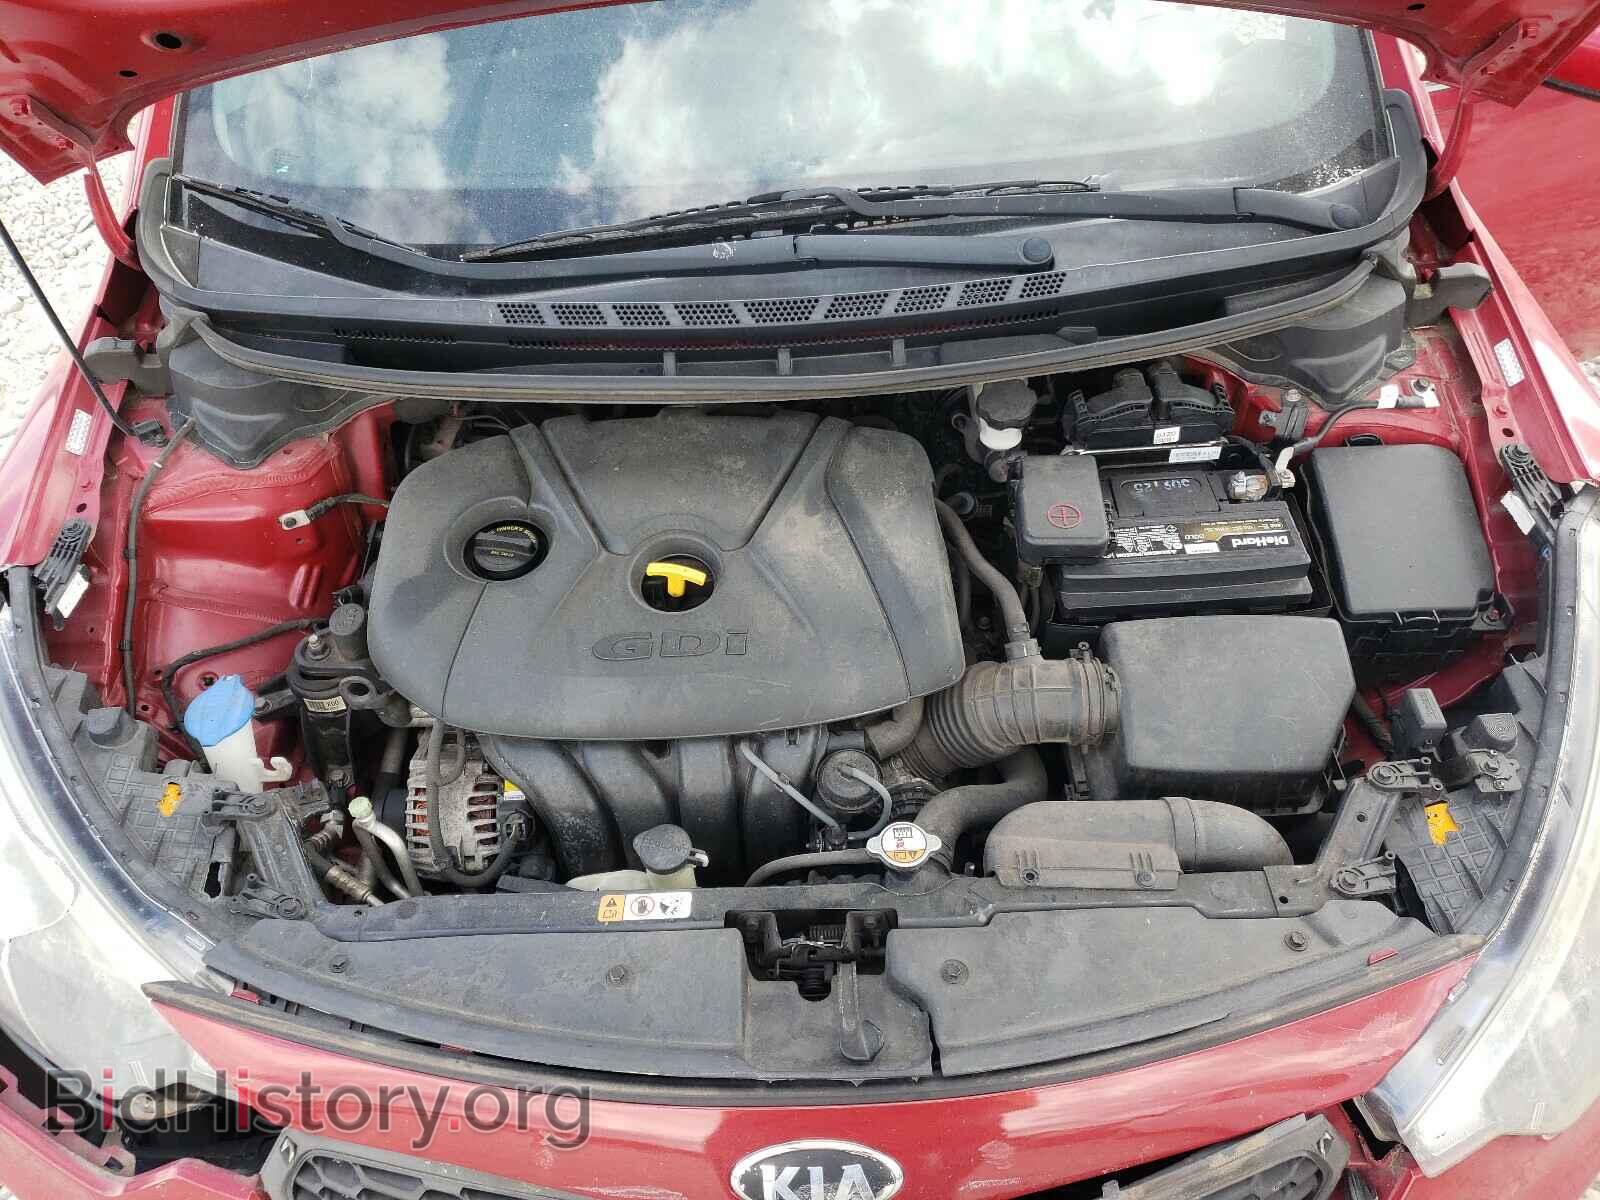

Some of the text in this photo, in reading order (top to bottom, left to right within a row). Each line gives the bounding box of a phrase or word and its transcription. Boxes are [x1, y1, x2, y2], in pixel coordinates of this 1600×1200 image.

[1231, 535, 1289, 548] DieHard
[592, 631, 749, 661] GDi
[760, 1163, 878, 1200] KIA
